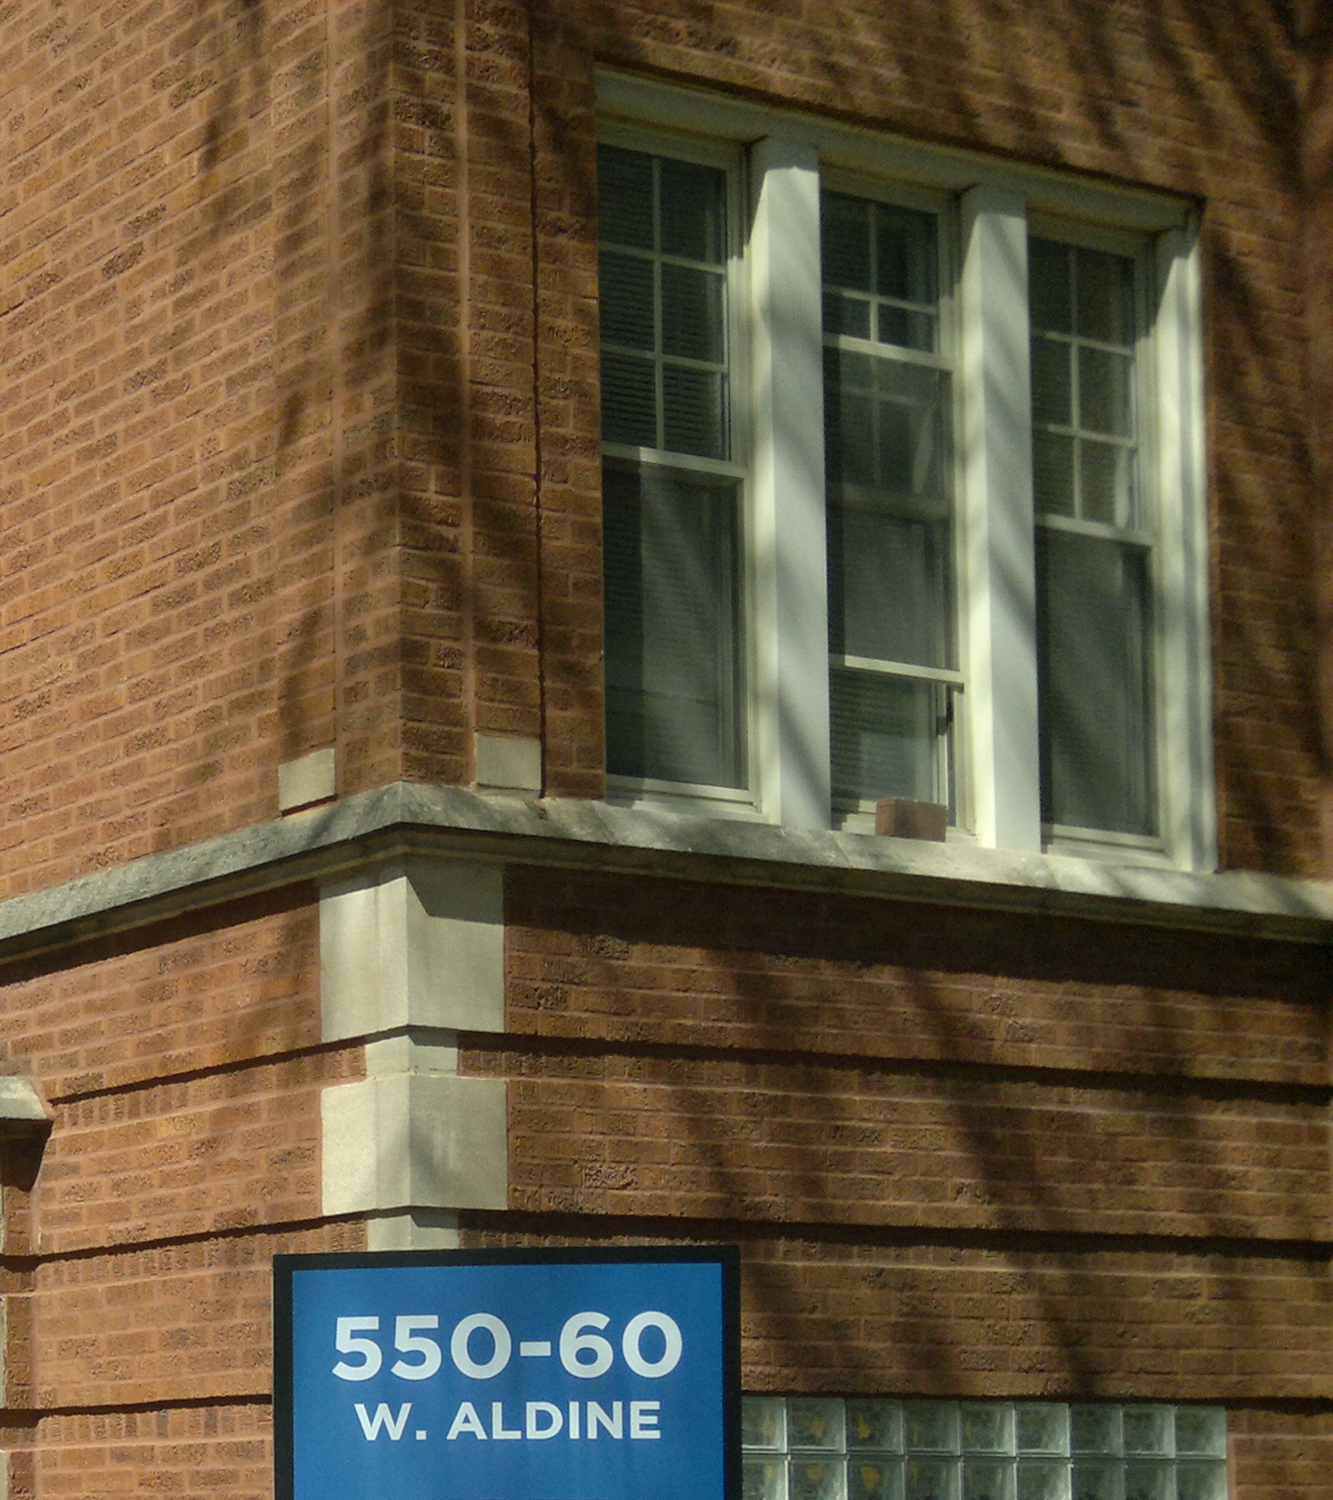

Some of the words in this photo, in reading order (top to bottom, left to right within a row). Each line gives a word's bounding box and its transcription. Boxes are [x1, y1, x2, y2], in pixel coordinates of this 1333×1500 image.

[332, 1311, 683, 1382] 550-60
[353, 1402, 427, 1441] W.
[446, 1400, 661, 1440] ALDINE
